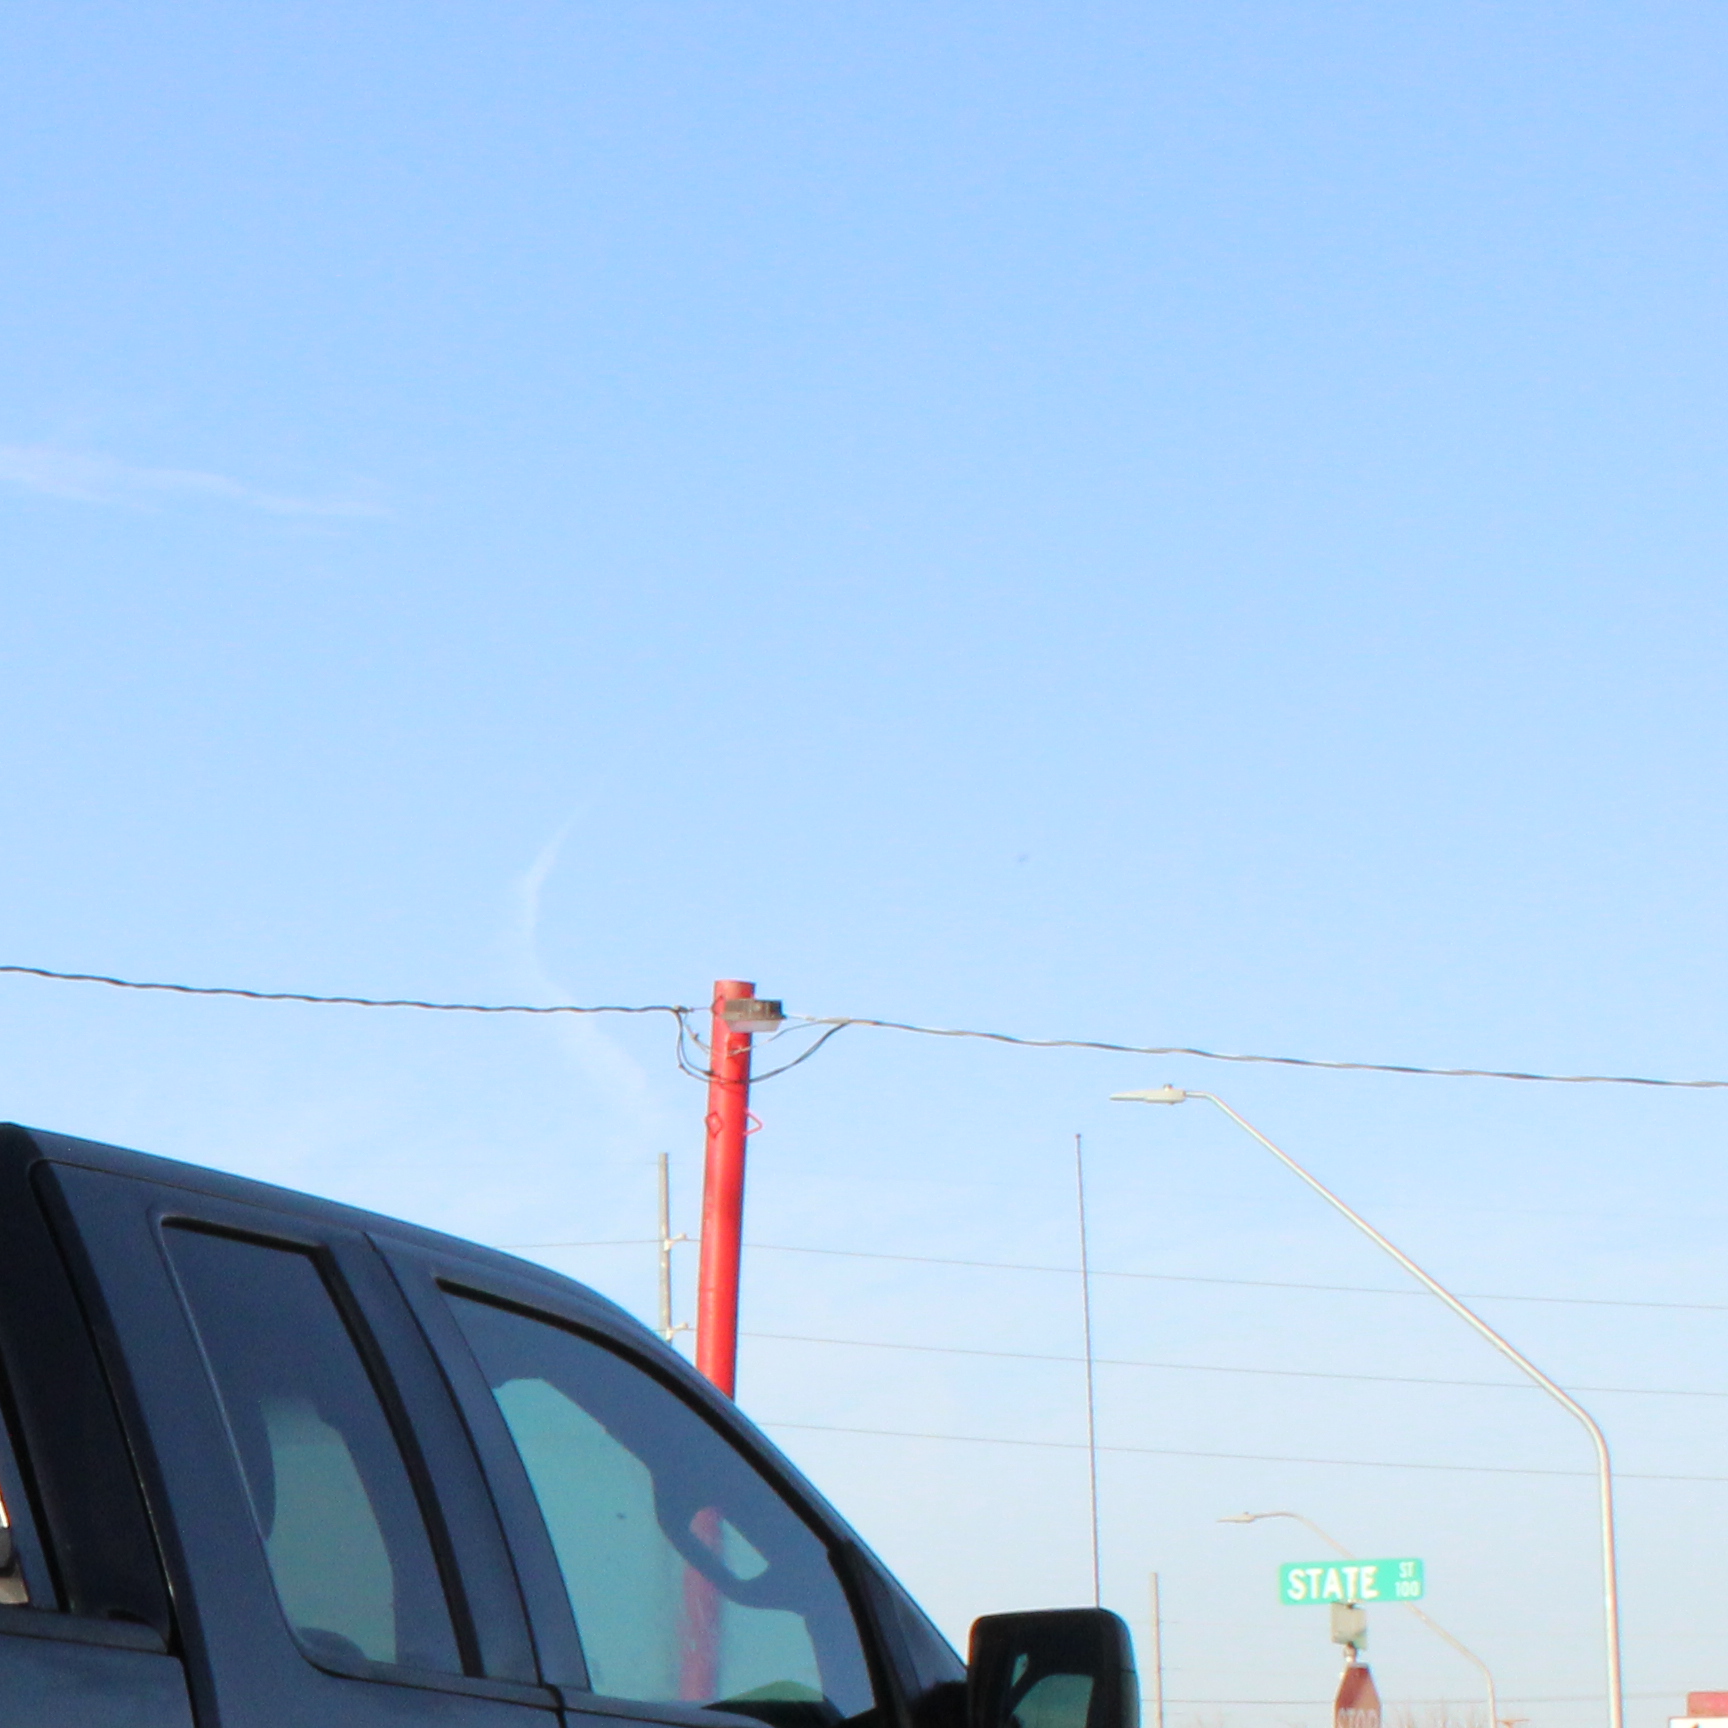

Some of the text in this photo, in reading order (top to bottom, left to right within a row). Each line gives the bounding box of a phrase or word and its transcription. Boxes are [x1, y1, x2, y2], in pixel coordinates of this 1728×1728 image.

[1287, 1561, 1415, 1600] STATE ST
[1395, 1581, 1421, 1597] 100
